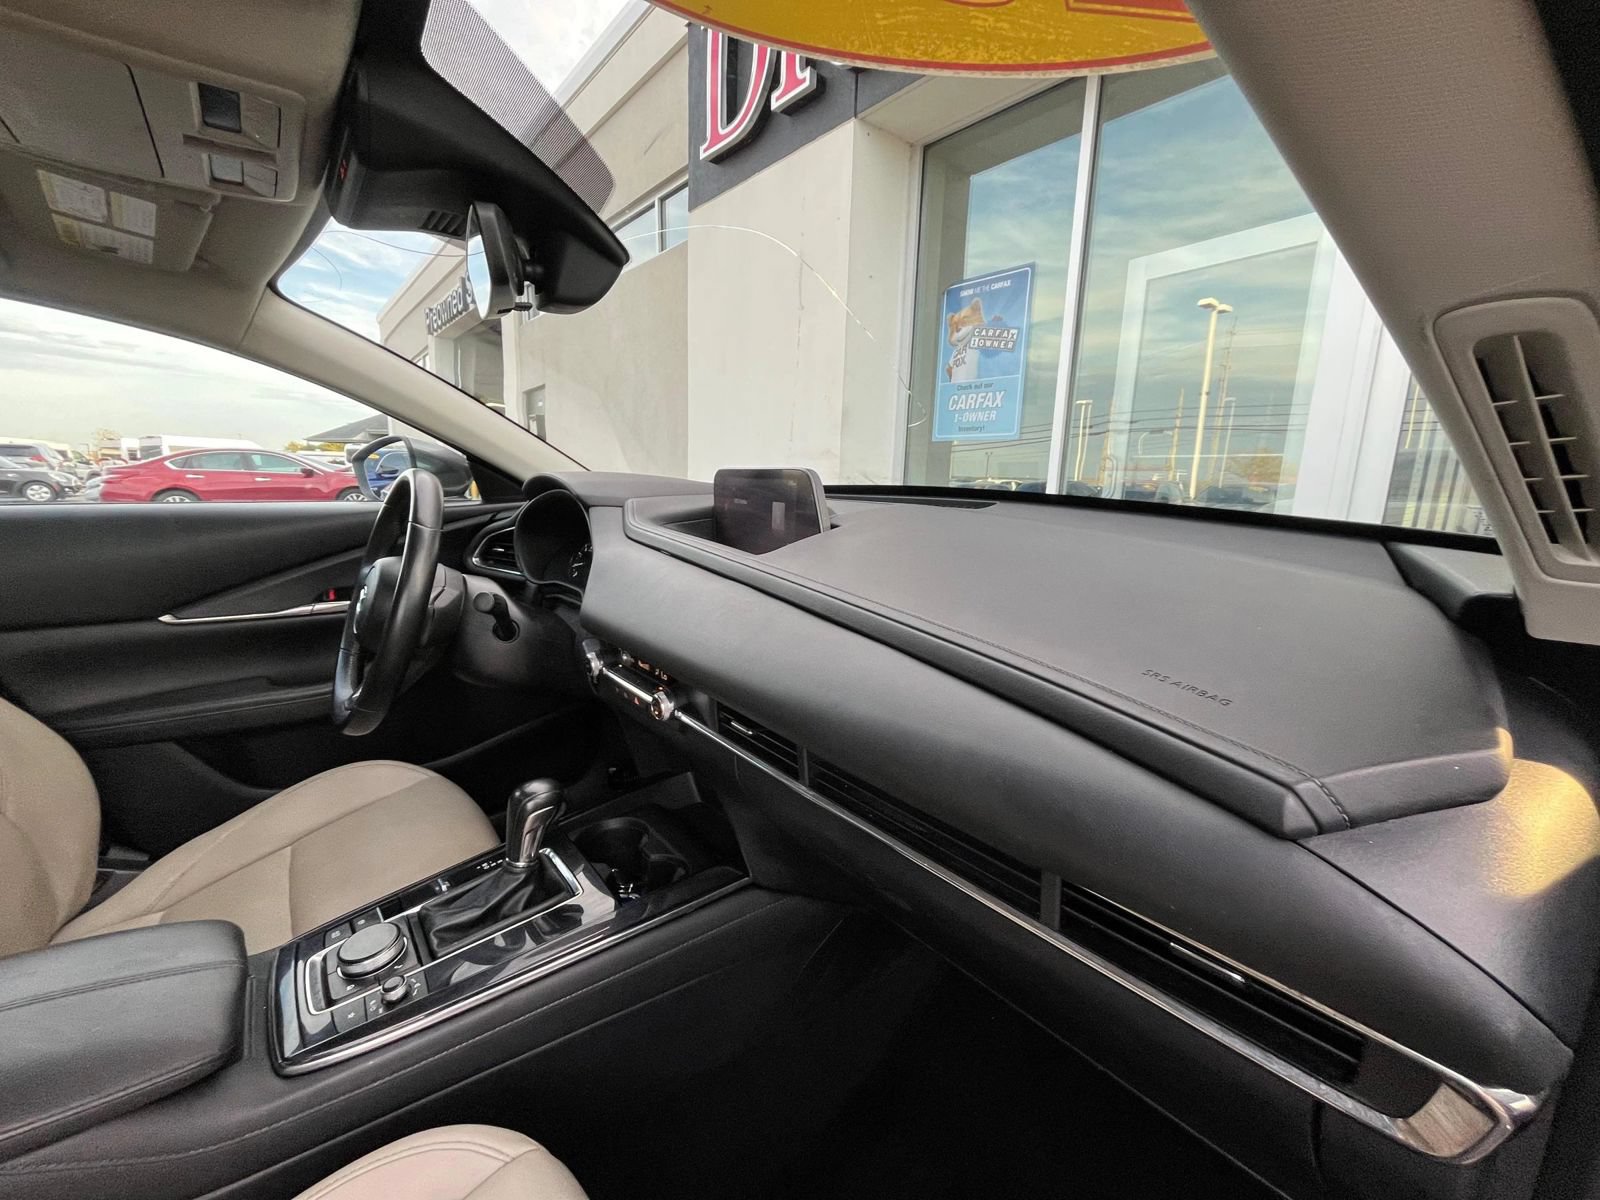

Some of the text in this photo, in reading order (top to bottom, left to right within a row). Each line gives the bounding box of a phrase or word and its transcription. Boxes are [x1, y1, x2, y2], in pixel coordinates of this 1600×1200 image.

[425, 276, 468, 335] Preowned
[974, 328, 1018, 340] CARFAX
[978, 339, 1014, 349] OWNER
[948, 391, 1005, 411] CARFAX
[954, 410, 996, 422] 1-OWNER
[1141, 669, 1233, 706] SRS AIRBAG
